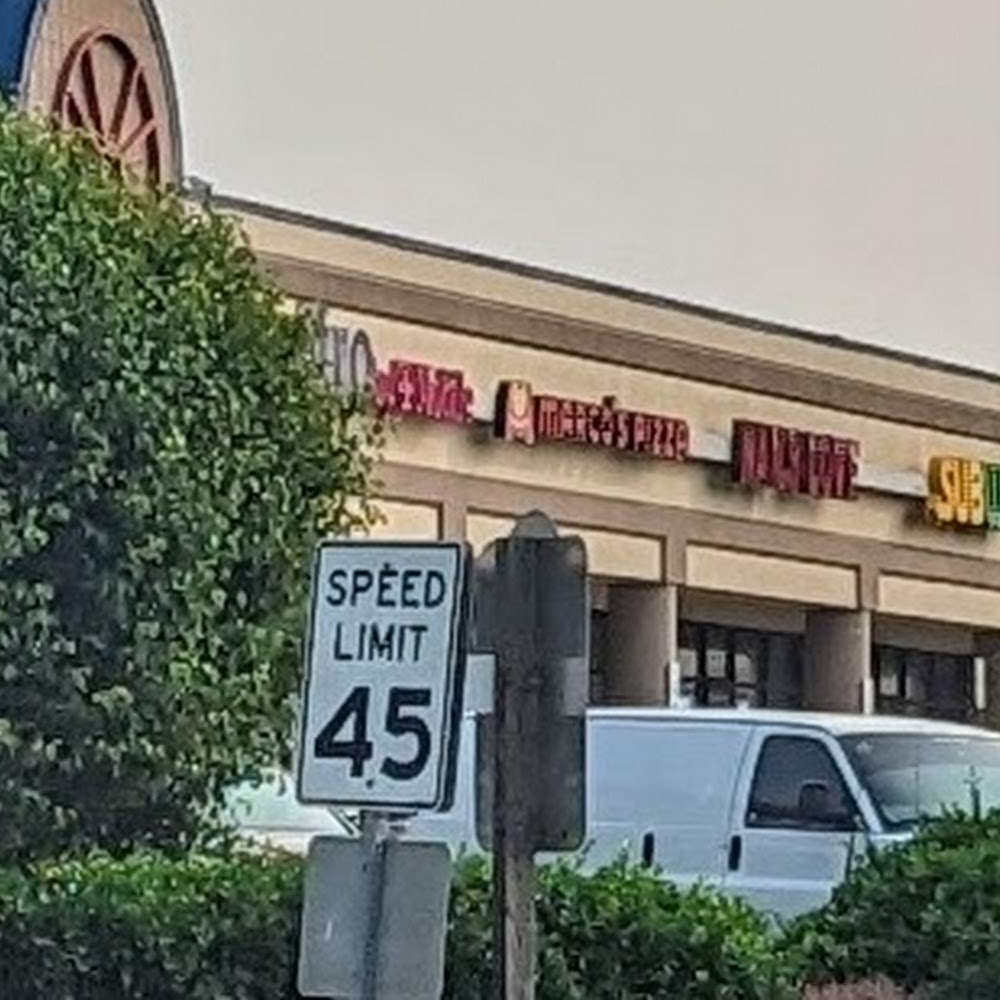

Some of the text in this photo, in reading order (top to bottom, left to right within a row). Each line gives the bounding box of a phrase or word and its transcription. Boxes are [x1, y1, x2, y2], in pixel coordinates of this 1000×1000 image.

[325, 569, 447, 609] SPEED
[333, 622, 429, 663] LIMIT
[313, 685, 432, 781] 45
